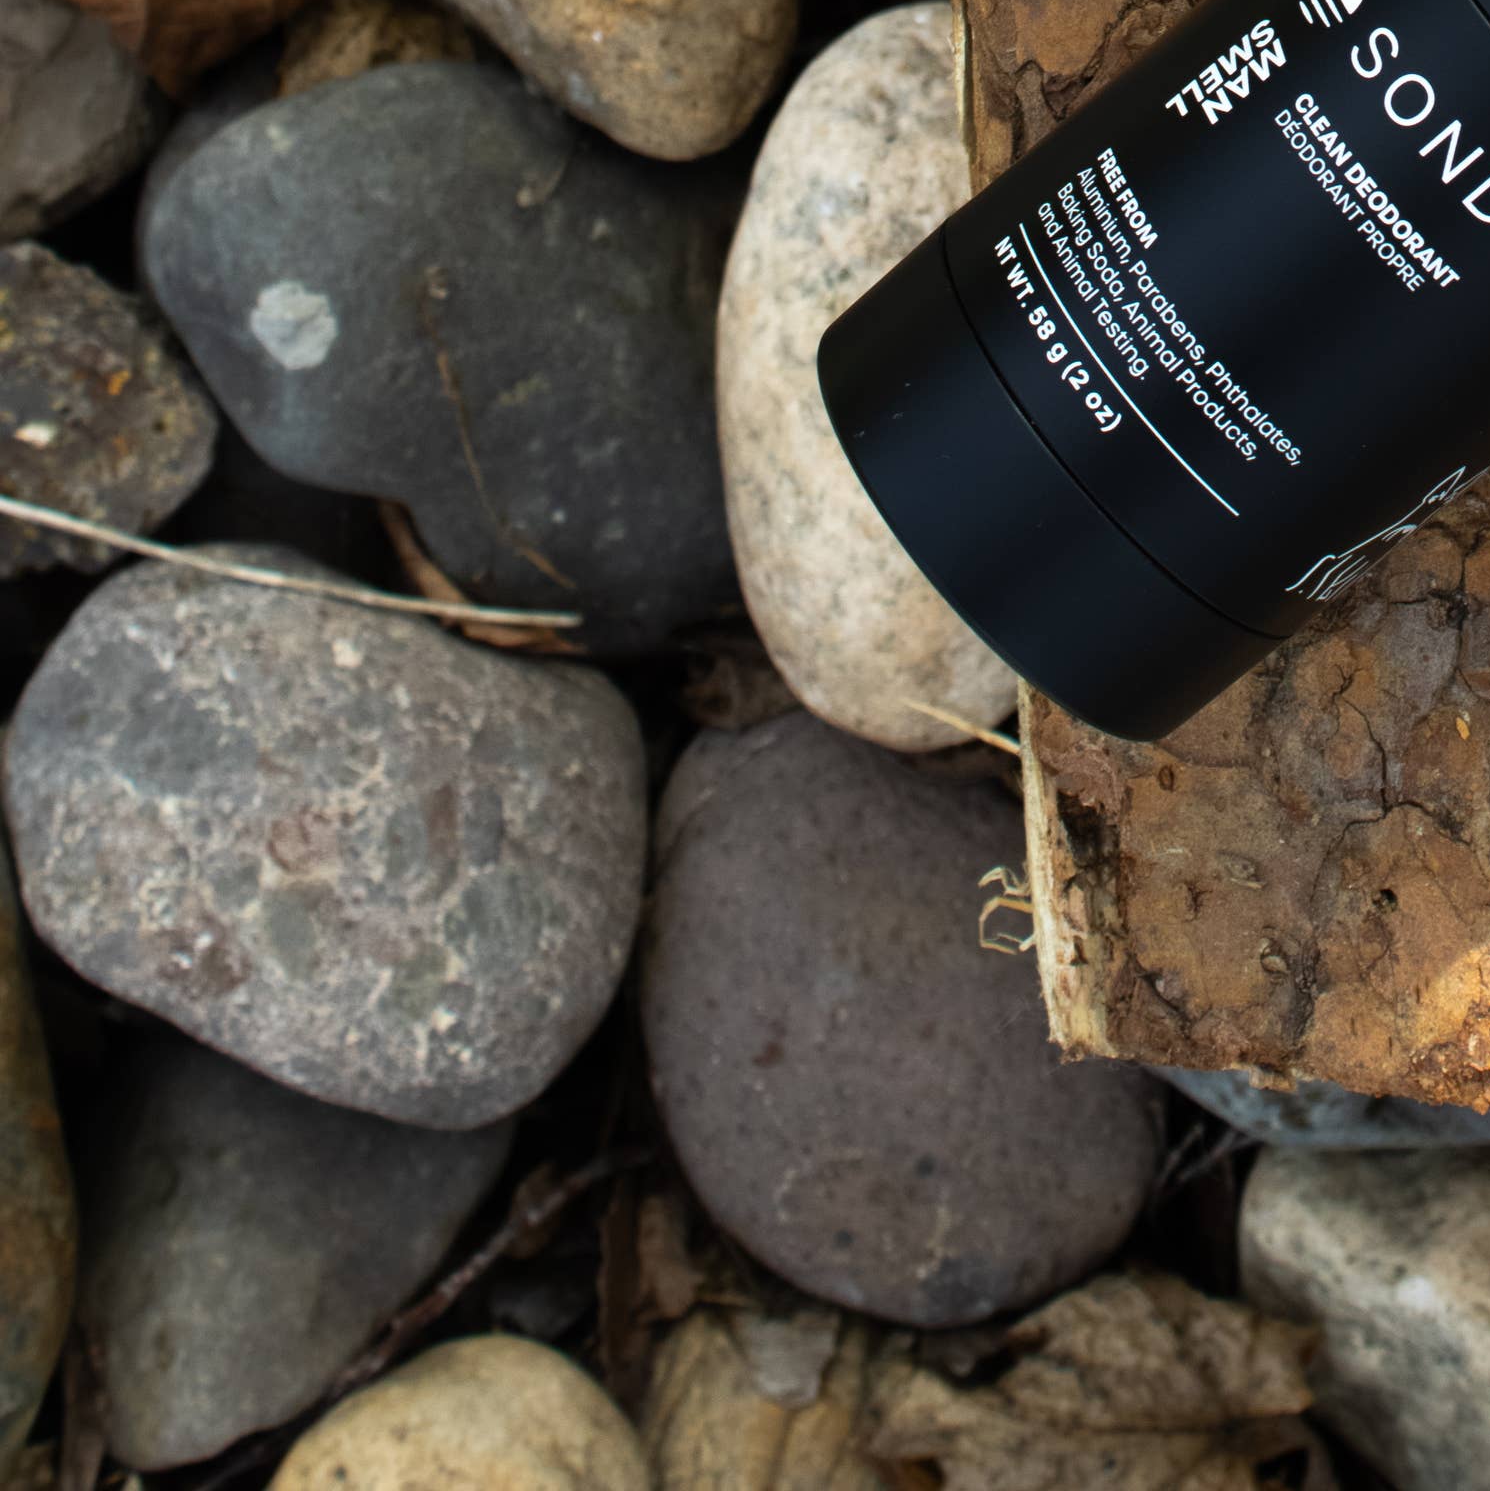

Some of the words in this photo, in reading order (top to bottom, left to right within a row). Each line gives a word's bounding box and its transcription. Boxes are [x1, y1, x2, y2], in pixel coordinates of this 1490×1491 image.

[1164, 19, 1277, 121] SMELL
[1200, 37, 1288, 127] MAN
[1097, 147, 1126, 197] FREE
[1115, 188, 1160, 250] FROM
[1273, 108, 1363, 227] DÉODORANT
[1356, 220, 1427, 293] PROPRE
[1293, 92, 1350, 169] CLEAN
[1343, 158, 1461, 290] DEODORANT
[994, 236, 1017, 265] NT
[1006, 262, 1036, 309] WT.
[1028, 305, 1057, 341] 58
[1046, 342, 1069, 364] g
[1061, 360, 1090, 391] (2
[1084, 392, 1123, 434] oz)
[1038, 202, 1063, 237] and
[1052, 236, 1099, 304] Animal
[1090, 297, 1151, 381] Testing.
[1057, 182, 1093, 246] Baking
[1087, 241, 1125, 303] Soda,
[1121, 301, 1183, 373] Animal
[1175, 369, 1258, 462] Products,
[1077, 167, 1132, 265] Aluminium,
[1128, 260, 1206, 366] Parabens,
[1205, 361, 1302, 466] Phthalates,
